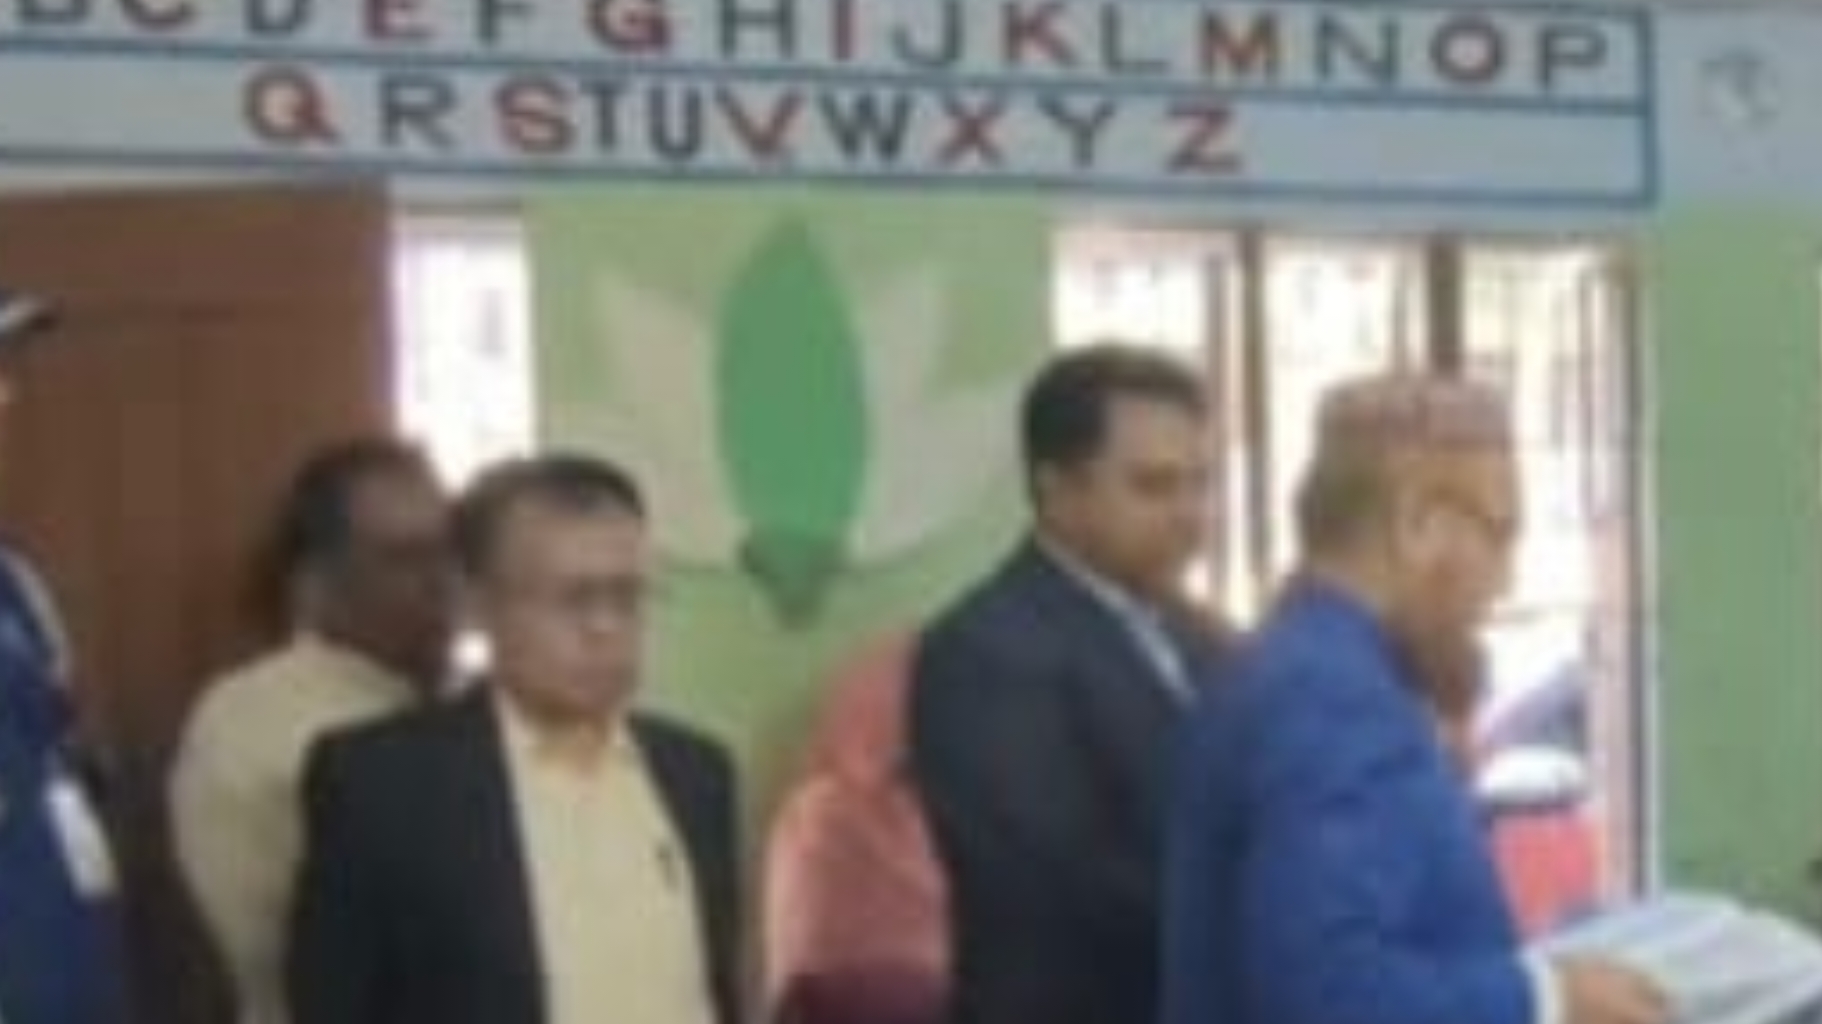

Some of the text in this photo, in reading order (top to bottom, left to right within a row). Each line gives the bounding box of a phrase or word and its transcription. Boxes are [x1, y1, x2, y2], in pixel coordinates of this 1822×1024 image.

[1008, 0, 1078, 66] K
[1103, 3, 1170, 73] L
[1203, 8, 1280, 82] M
[1317, 13, 1394, 82] N
[1430, 15, 1504, 83] O
[1539, 24, 1607, 90] P
[243, 64, 338, 144] Q
[379, 74, 457, 148] R
[494, 75, 575, 152] S
[650, 86, 702, 159] U
[715, 88, 805, 160] V
[817, 92, 910, 162] W
[934, 92, 1004, 165] X
[1040, 96, 1115, 167] Y
[1164, 102, 1241, 173] Z
